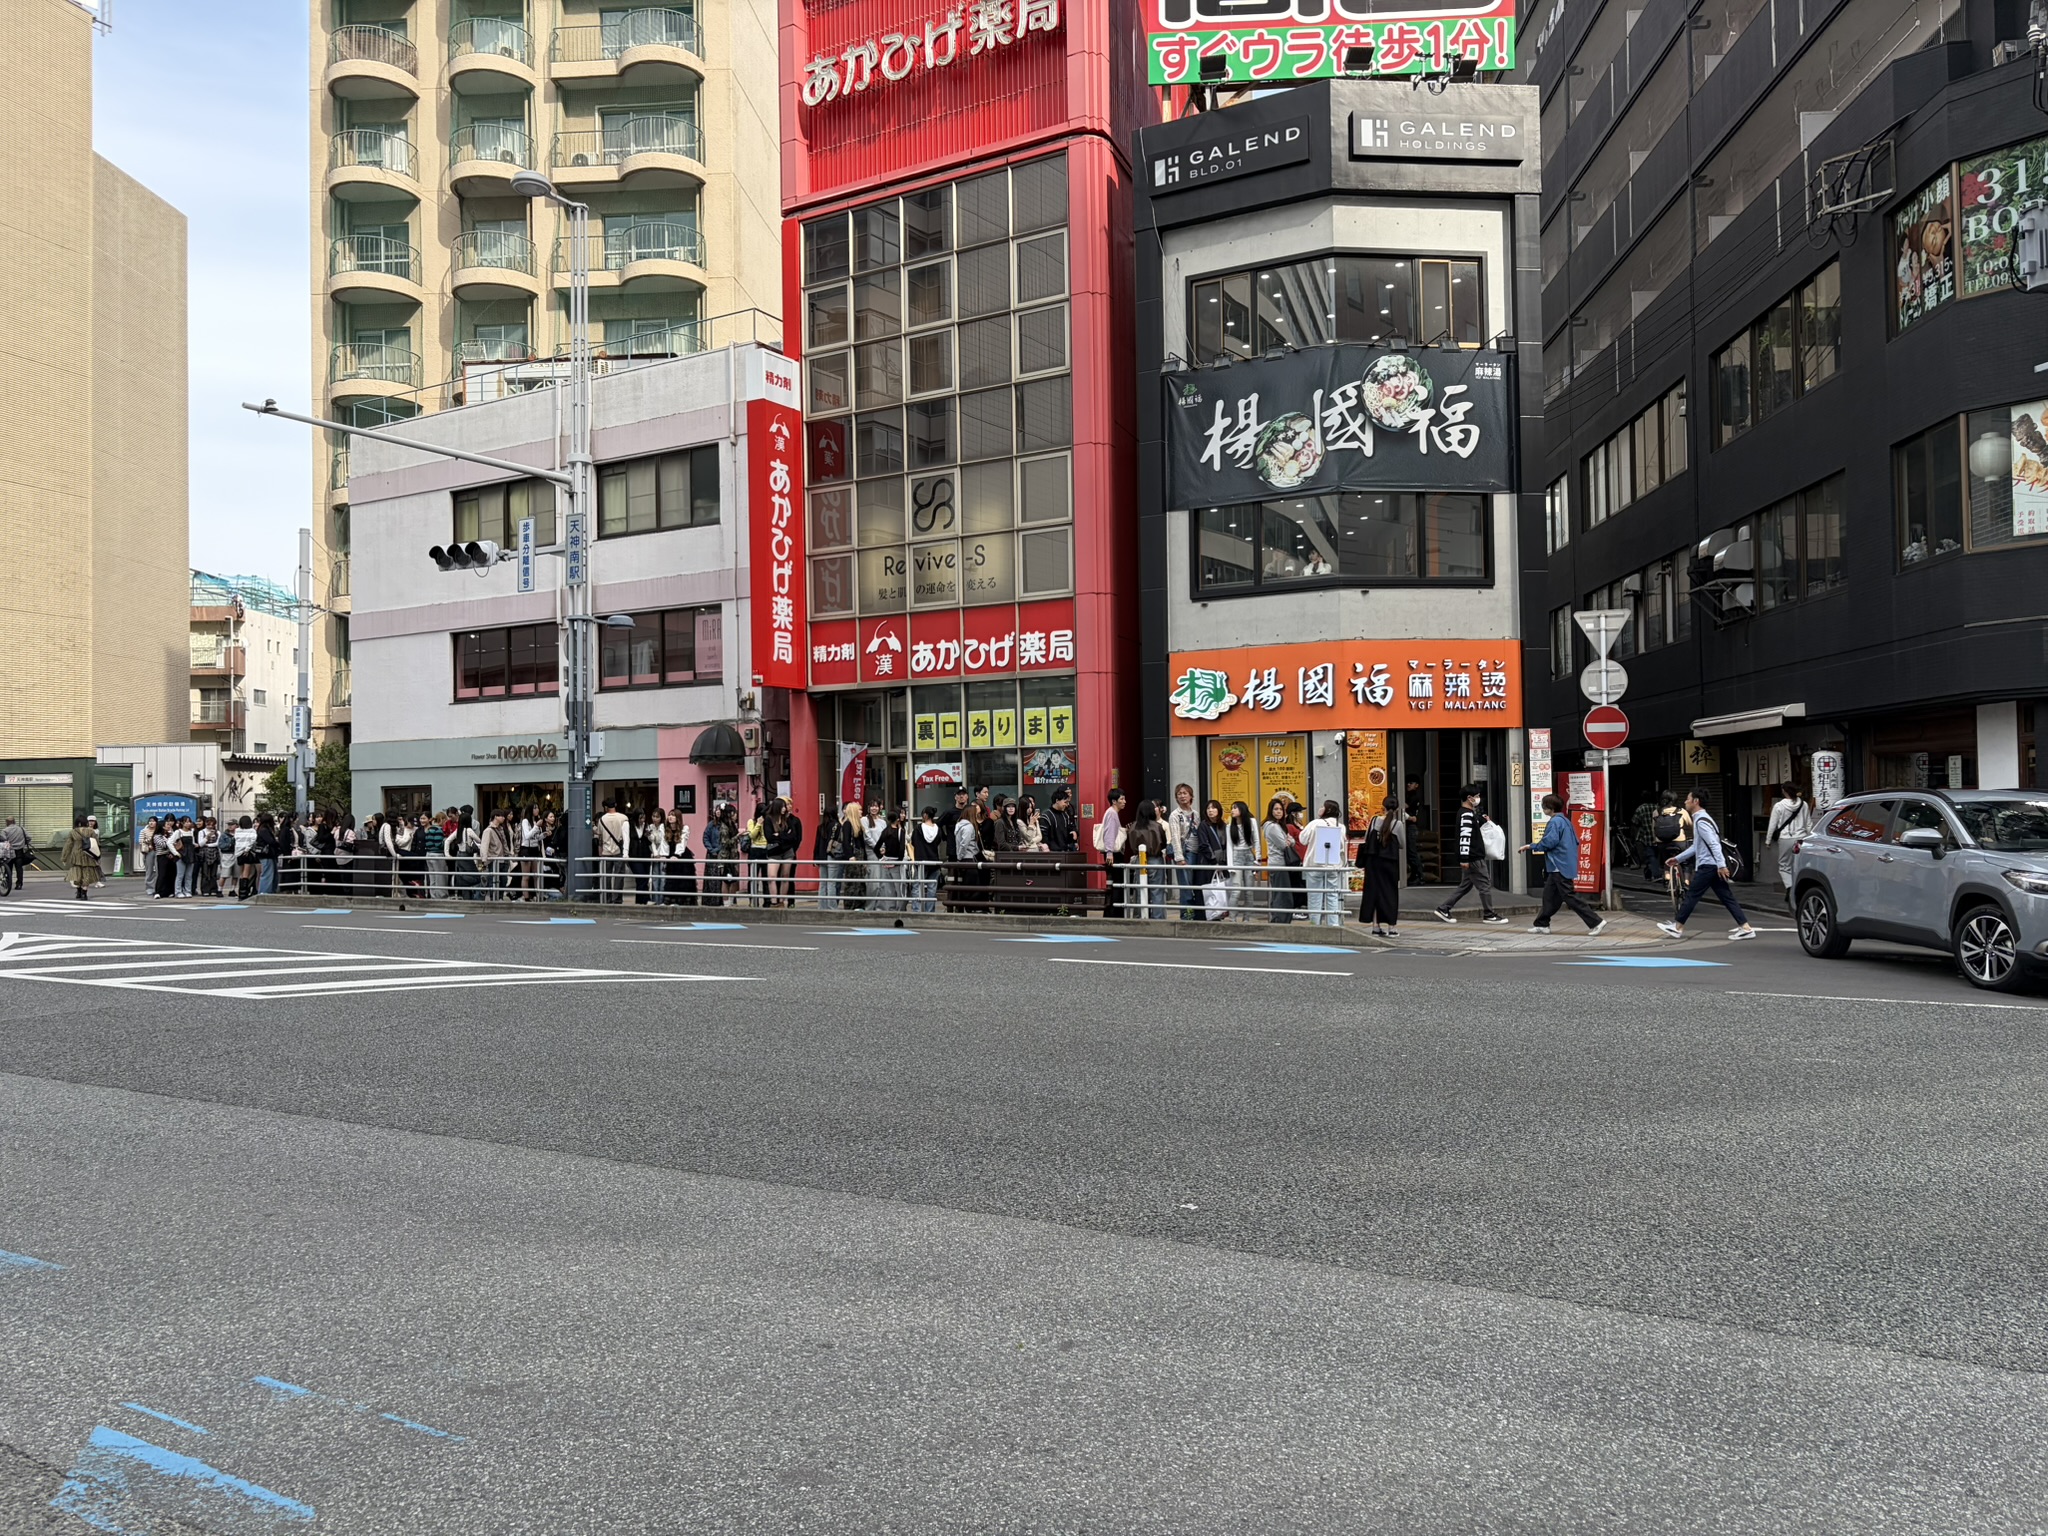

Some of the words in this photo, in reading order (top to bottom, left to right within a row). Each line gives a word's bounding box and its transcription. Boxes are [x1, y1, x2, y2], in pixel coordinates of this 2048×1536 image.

[802, 0, 1058, 107] あかひげ薬局
[1400, 121, 1516, 138] GALEND
[1189, 127, 1301, 164] GALEND
[1400, 139, 1487, 151] HOLDINGS
[1921, 172, 1950, 213] 小顔
[1923, 272, 1953, 311] 矯正
[765, 370, 792, 392] 精力剤
[774, 434, 786, 453] 漢
[522, 521, 531, 589] 歩車分離信号
[569, 519, 581, 580] 天神南駅
[769, 457, 793, 665] あかひげ薬局
[878, 577, 997, 600] 髪と肌の運命を変える
[812, 642, 855, 664] 精力剤
[911, 630, 1074, 673] あかひげ薬局
[875, 653, 893, 676] 漢
[1408, 659, 1505, 669] マーラータン
[1240, 662, 1394, 711] 楊國福
[1409, 700, 1434, 710] YGF
[1445, 700, 1507, 710] MALATANG
[917, 713, 1070, 741] 裏口あります
[497, 738, 557, 760] nonoka
[1266, 739, 1286, 748] How
[854, 757, 863, 776] Tax
[1264, 755, 1289, 764] Enjoy
[852, 777, 862, 800] Free
[922, 774, 934, 782] Tax
[934, 774, 950, 782] Free
